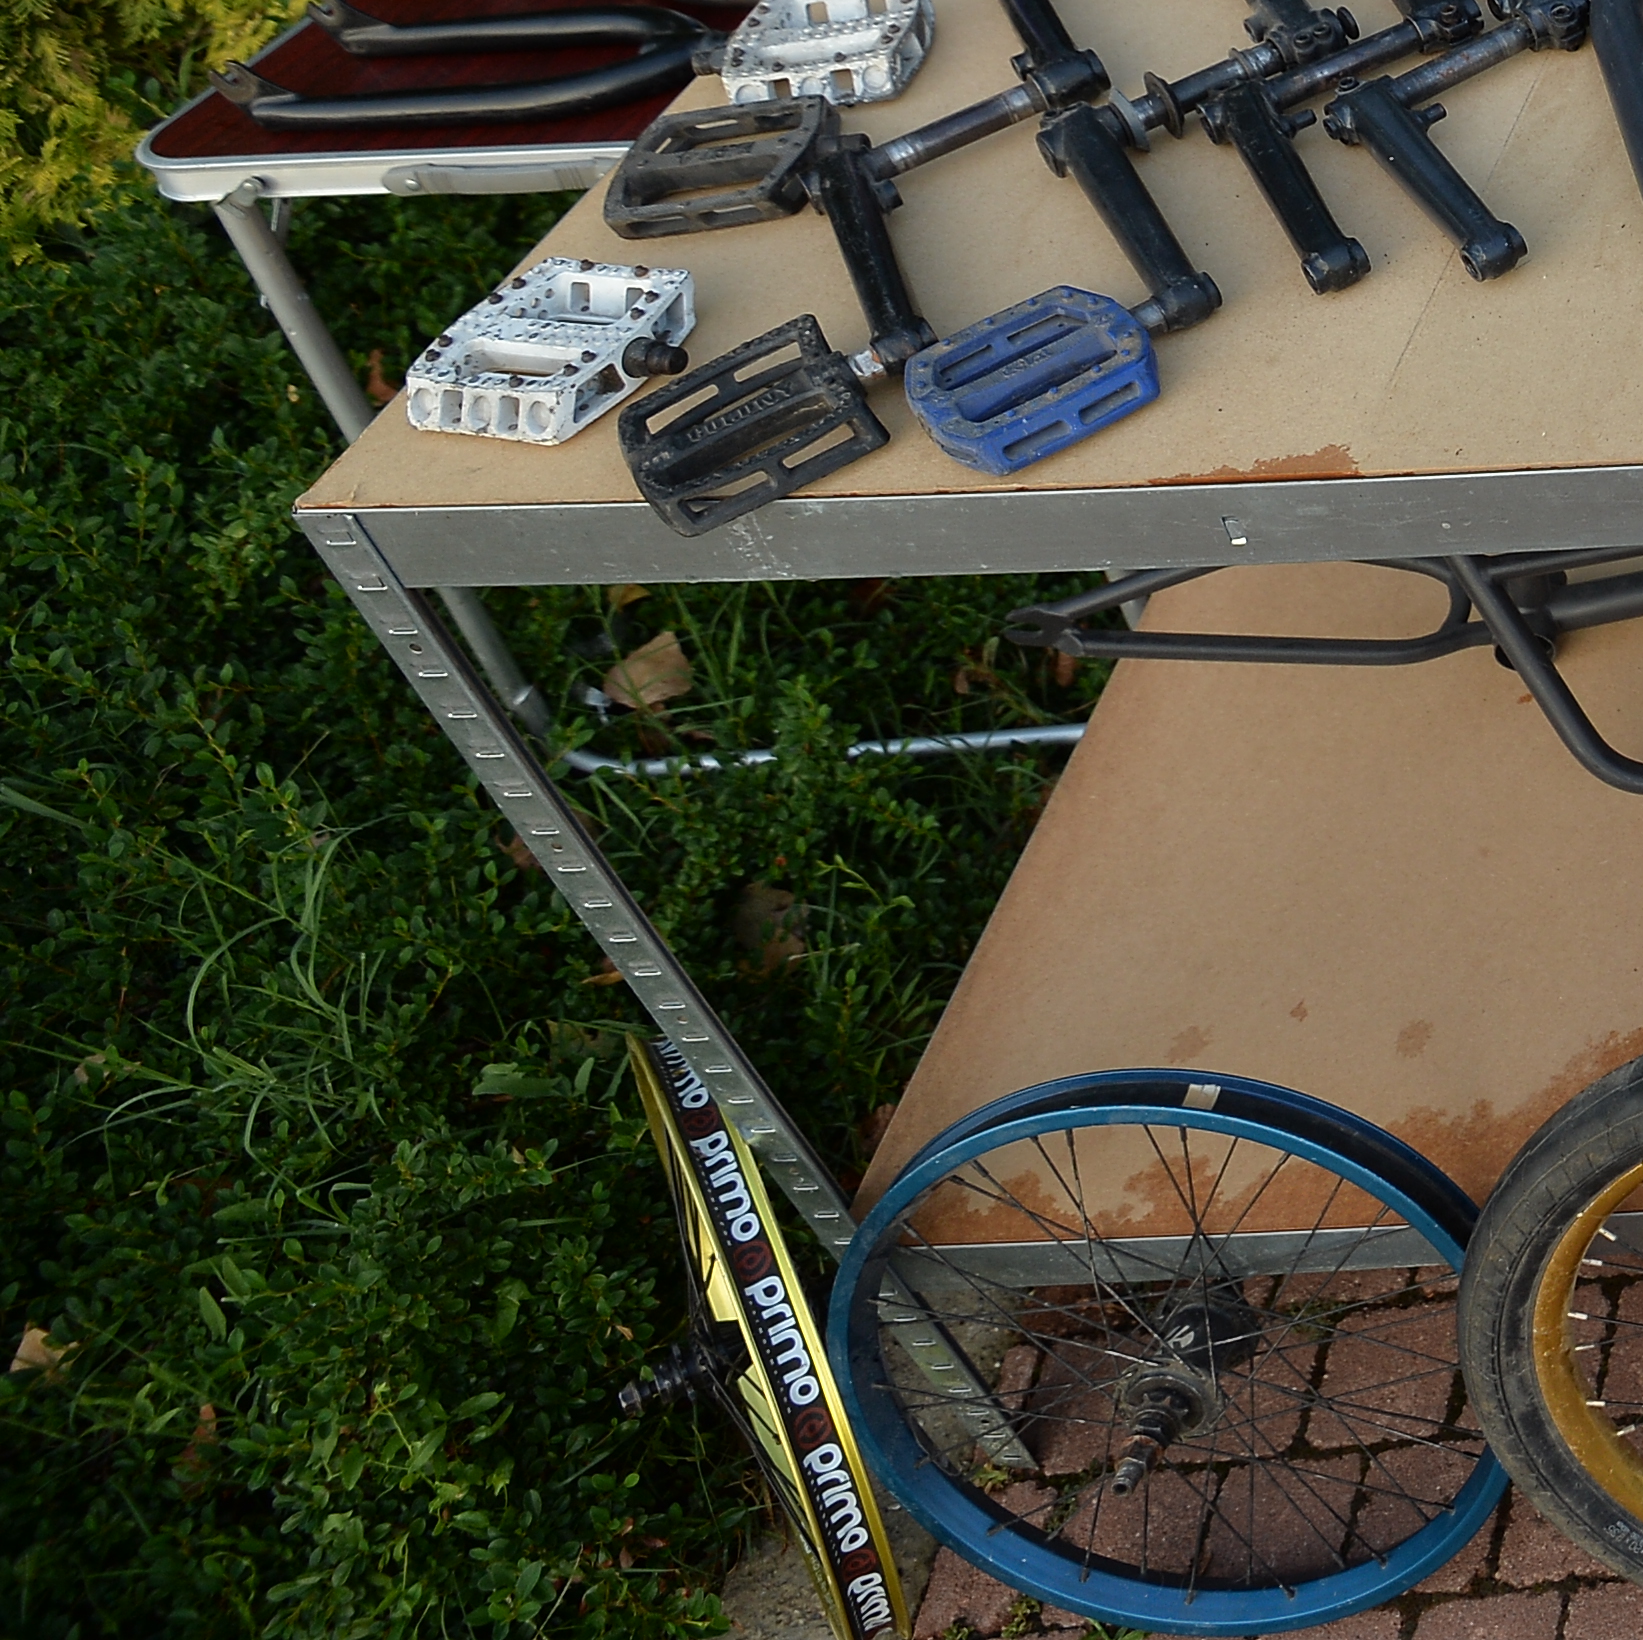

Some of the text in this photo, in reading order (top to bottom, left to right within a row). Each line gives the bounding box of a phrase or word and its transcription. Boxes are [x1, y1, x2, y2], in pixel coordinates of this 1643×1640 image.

[690, 1130, 760, 1242] primo
[746, 1274, 820, 1407] primo
[803, 1443, 869, 1552] primo
